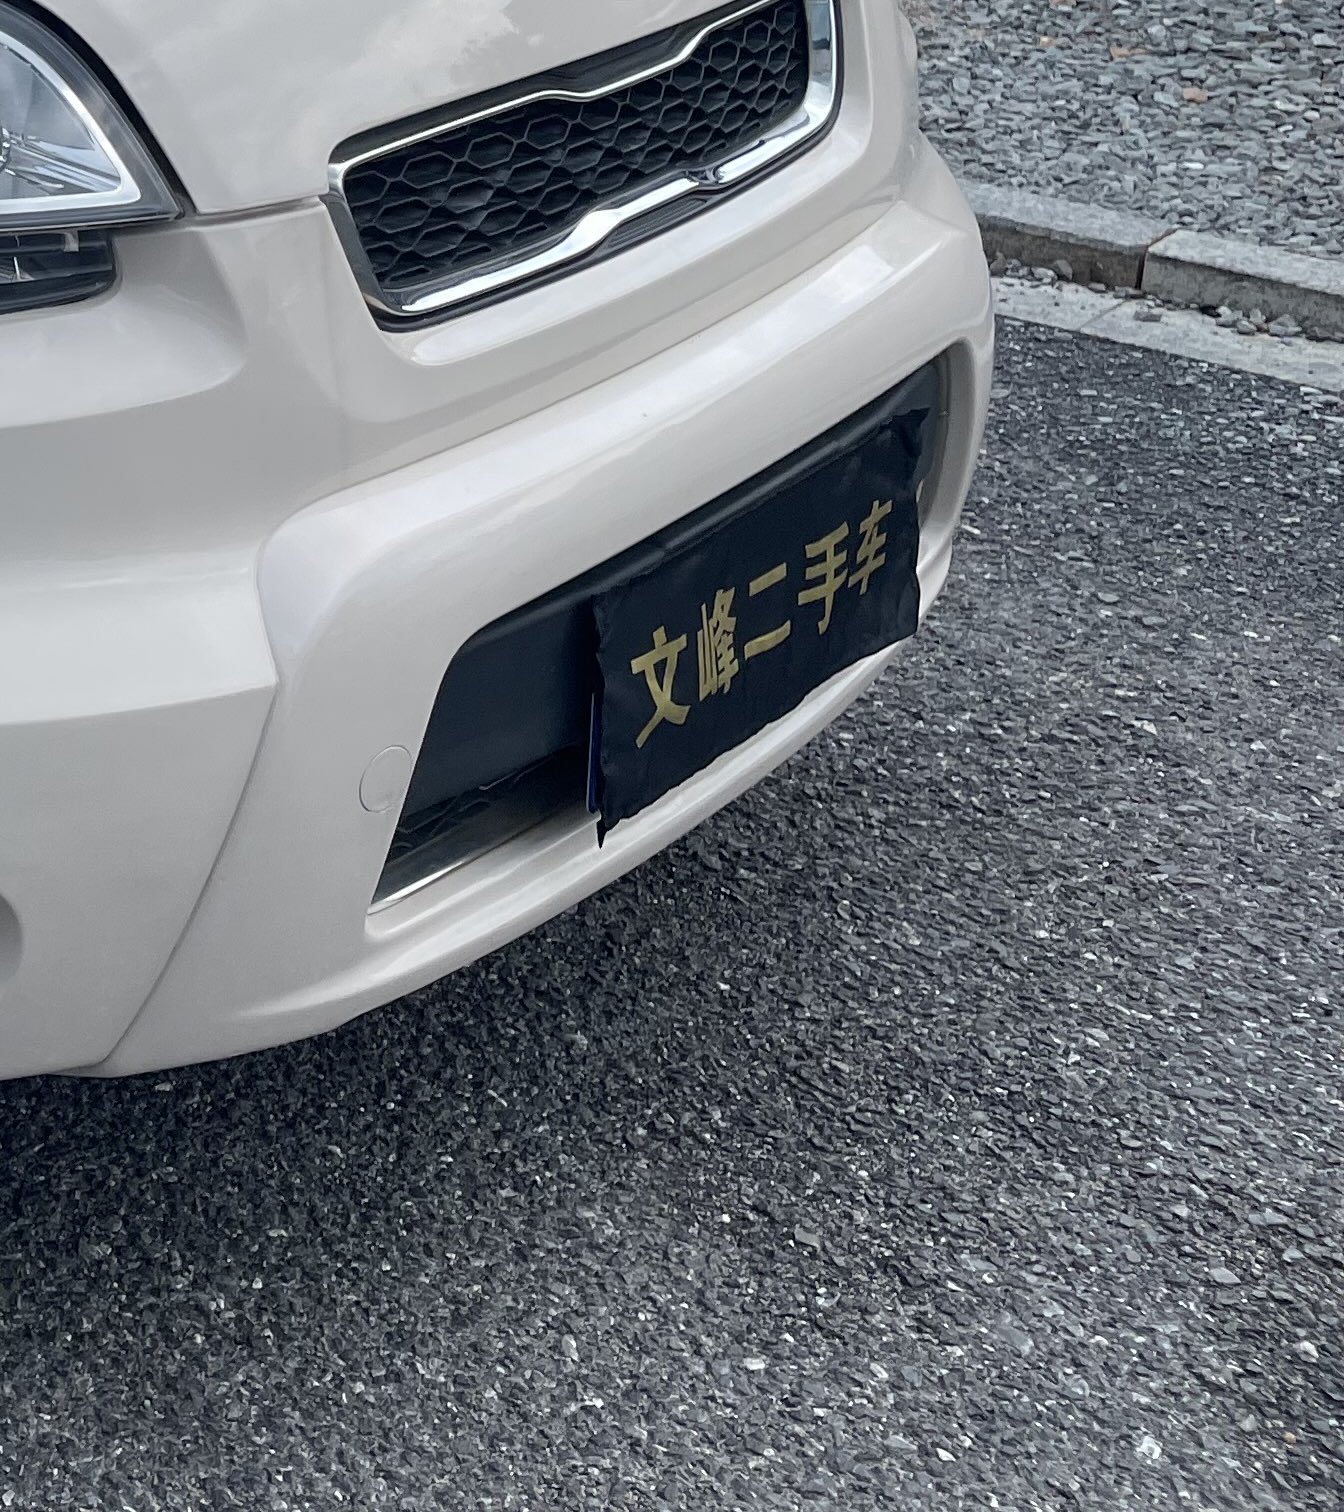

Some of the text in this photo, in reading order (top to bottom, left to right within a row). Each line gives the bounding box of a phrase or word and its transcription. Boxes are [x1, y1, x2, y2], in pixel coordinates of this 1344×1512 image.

[630, 499, 893, 749] 文峰二手车
